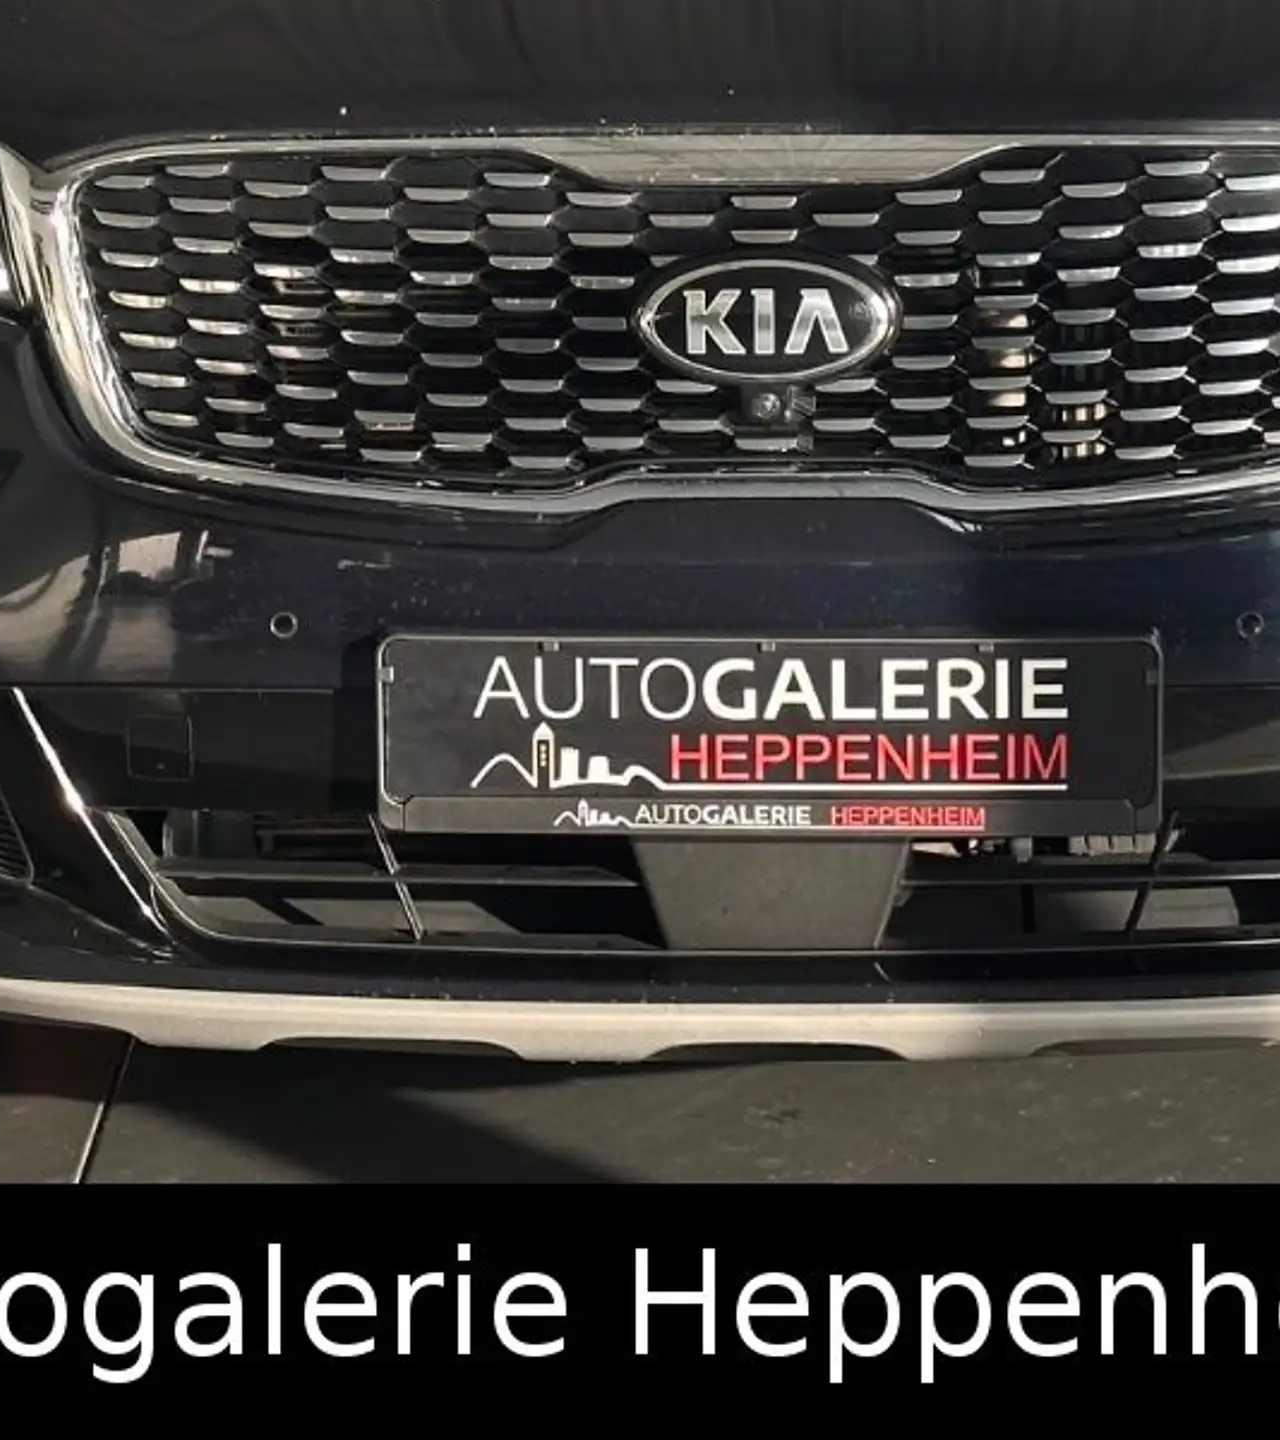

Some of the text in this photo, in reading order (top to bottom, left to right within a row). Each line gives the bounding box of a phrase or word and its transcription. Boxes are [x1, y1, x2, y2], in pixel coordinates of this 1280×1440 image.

[682, 287, 850, 356] KIA
[473, 655, 1068, 721] AUTOGALERIE
[670, 733, 1068, 782] HEPPENHEIM
[634, 803, 987, 827] AUTOGALERIE HEPPENHEIM
